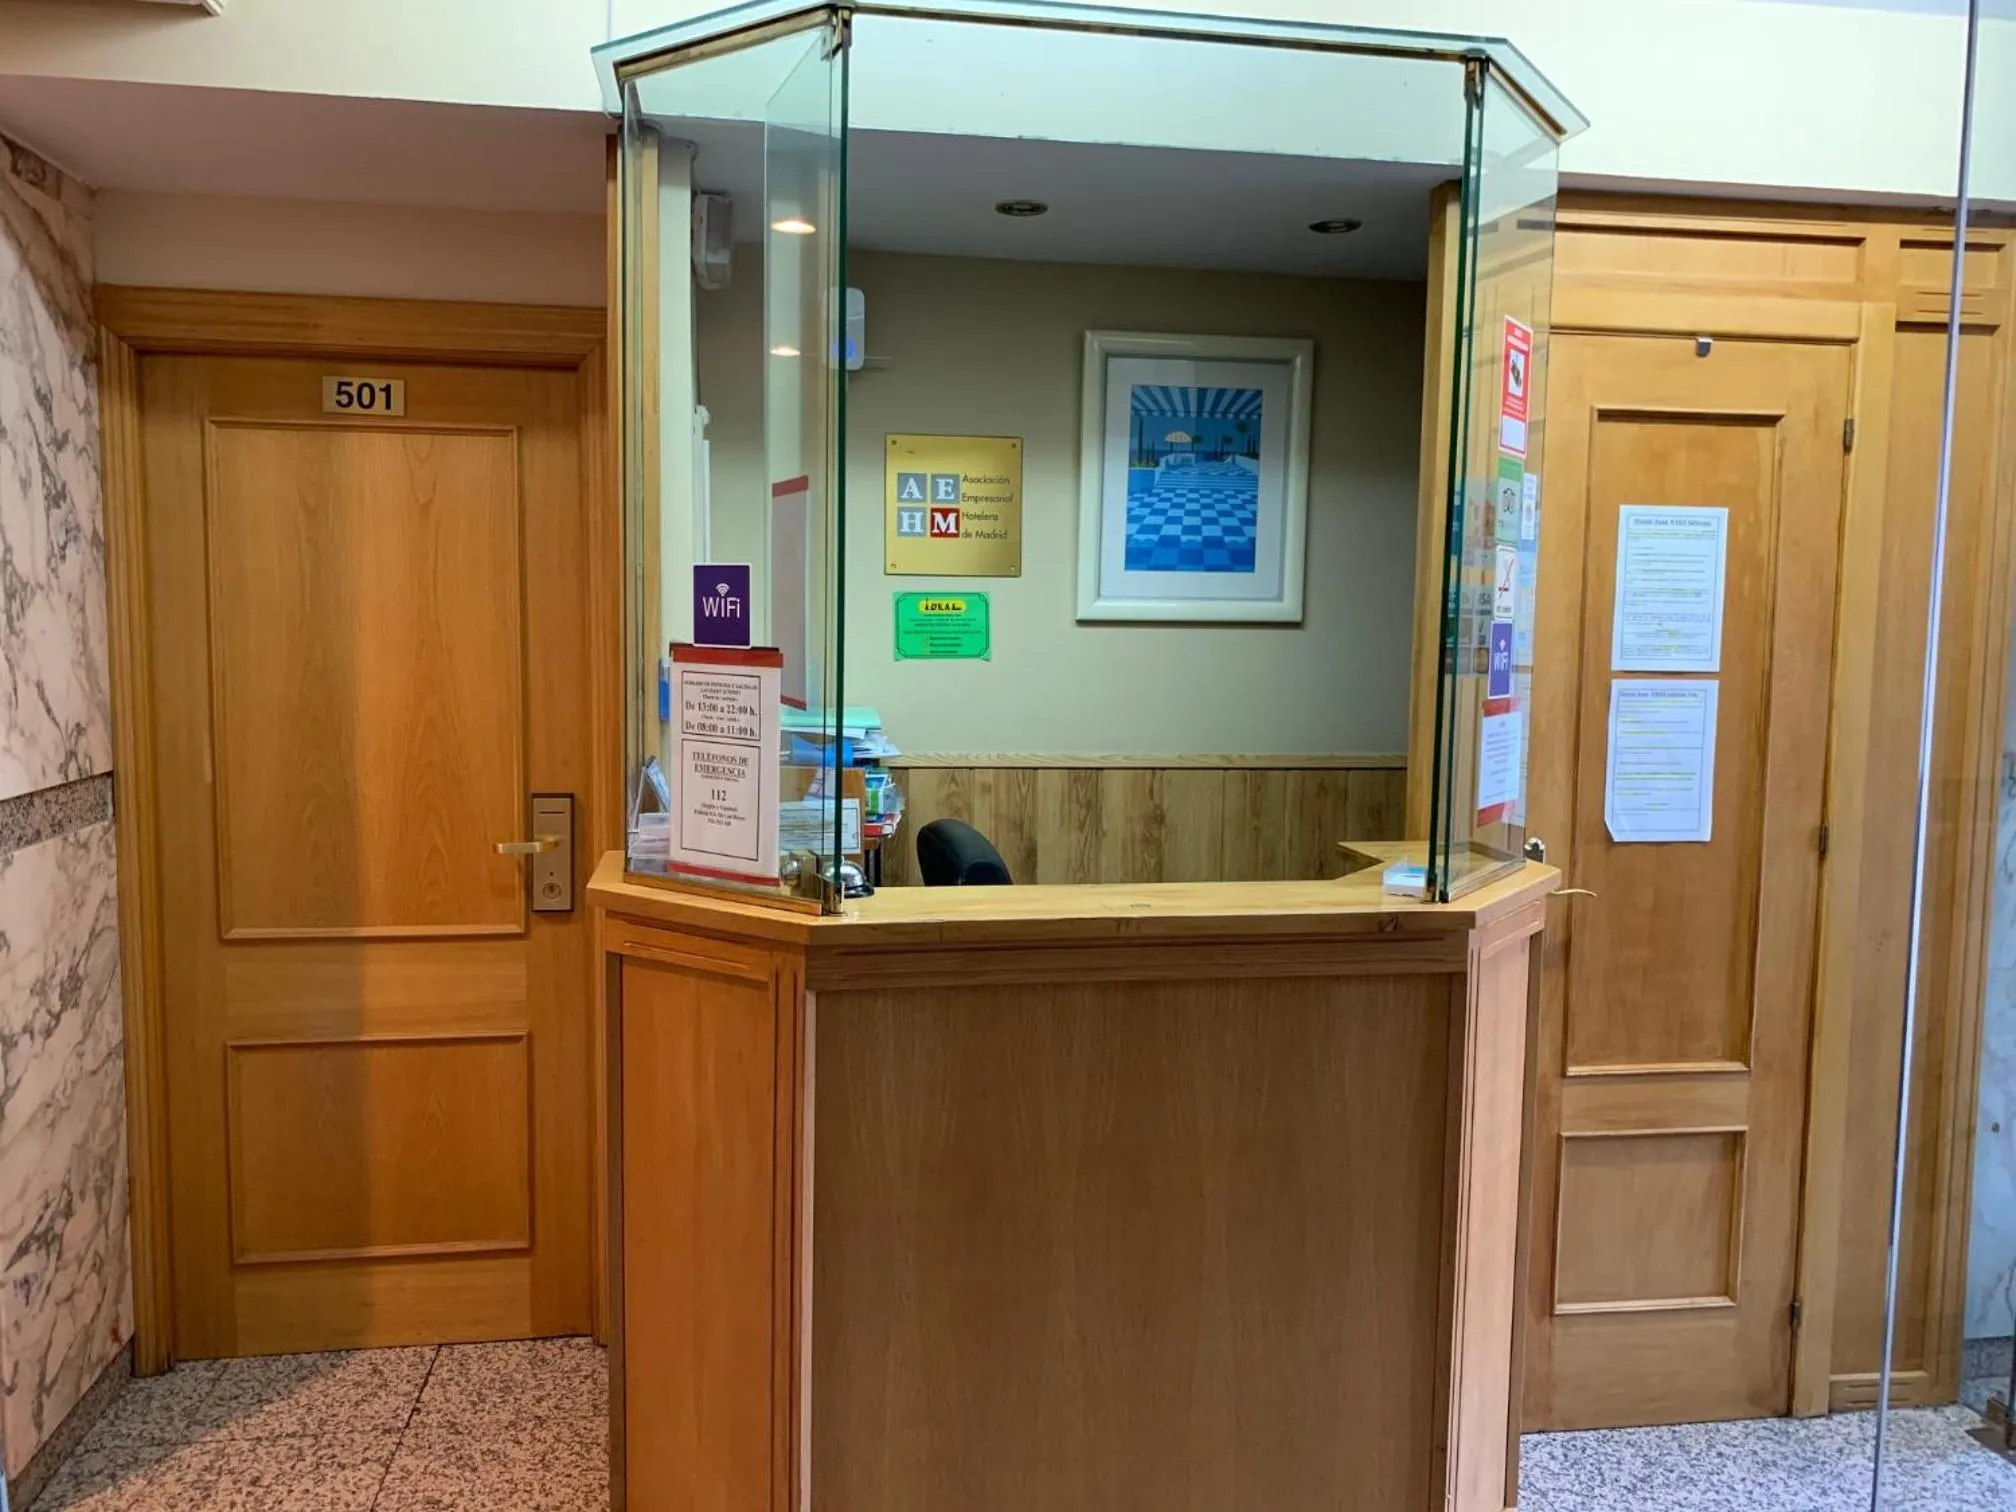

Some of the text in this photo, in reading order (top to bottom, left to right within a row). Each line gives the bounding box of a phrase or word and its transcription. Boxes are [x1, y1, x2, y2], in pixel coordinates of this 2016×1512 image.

[335, 381, 392, 410] 501
[901, 476, 955, 500] A E
[961, 492, 1013, 504] Empresarial
[900, 511, 959, 533] H M
[961, 511, 999, 521] Hotelera
[961, 529, 1008, 539] de Madrid
[702, 596, 740, 618] WiFi
[693, 762, 746, 778] EMERGENCIA
[711, 788, 727, 802] 112
